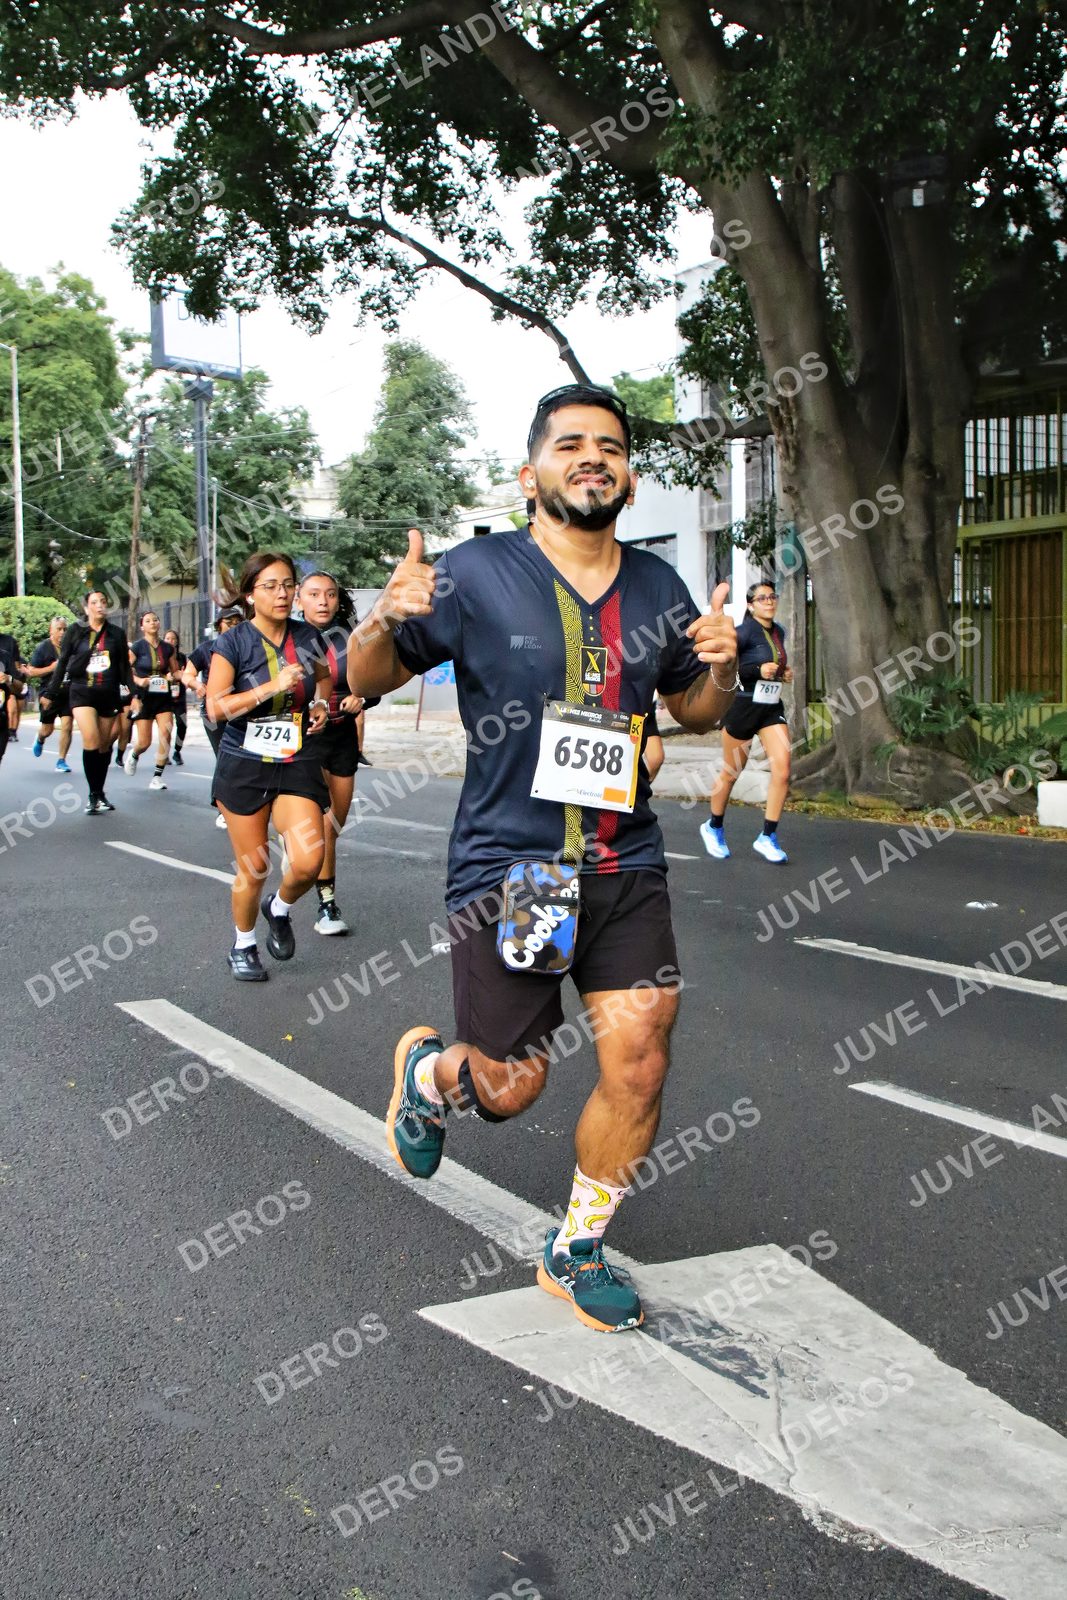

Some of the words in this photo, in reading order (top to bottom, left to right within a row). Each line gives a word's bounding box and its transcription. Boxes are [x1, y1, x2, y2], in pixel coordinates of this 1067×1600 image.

[760, 683, 780, 694] 7617
[254, 725, 291, 742] 7574
[554, 735, 624, 776] 6588
